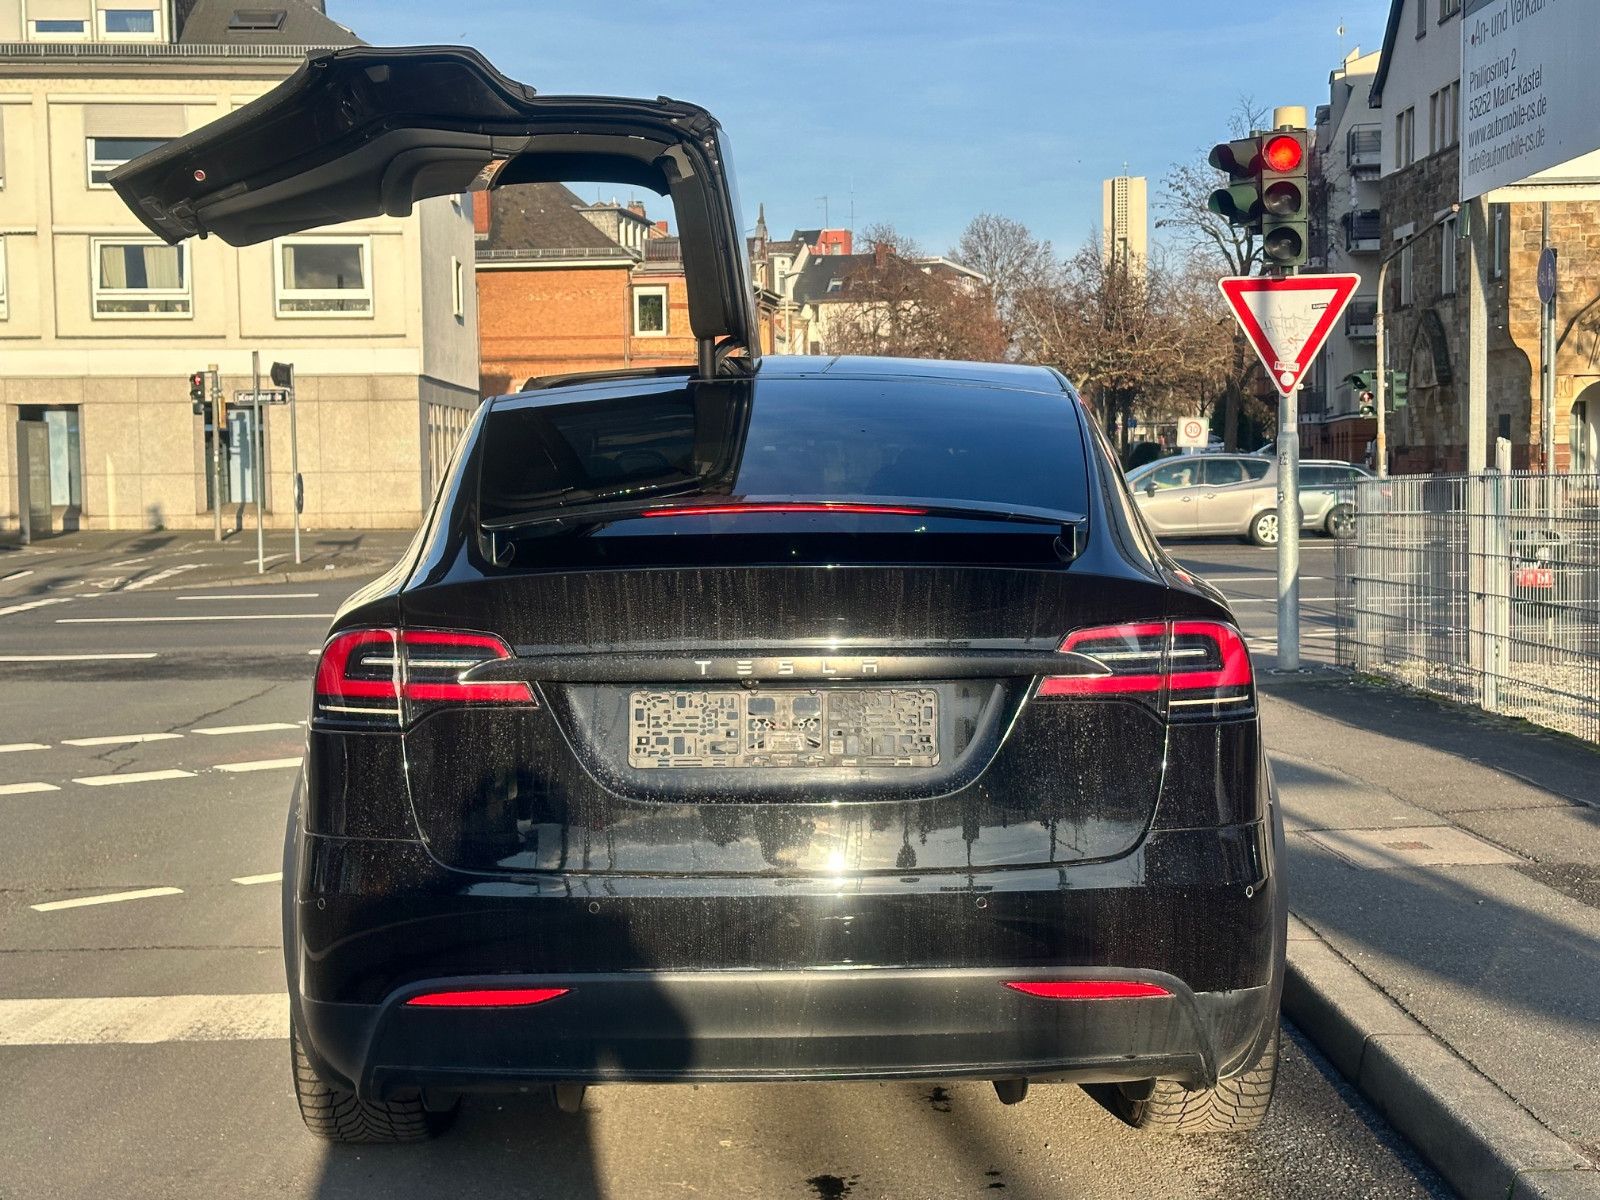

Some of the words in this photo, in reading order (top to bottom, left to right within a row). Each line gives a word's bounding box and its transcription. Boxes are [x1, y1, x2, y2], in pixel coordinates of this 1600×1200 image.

[1491, 2, 1508, 37] und
[1511, 48, 1517, 71] 2
[1469, 91, 1491, 121] 55252
[1492, 63, 1542, 109] Mainz-Kastel
[1468, 93, 1547, 148] www.automobile-cs.de
[1468, 124, 1545, 176] info@automobile-cs.de
[1187, 425, 1199, 434] 30
[694, 660, 878, 675] TESLA
